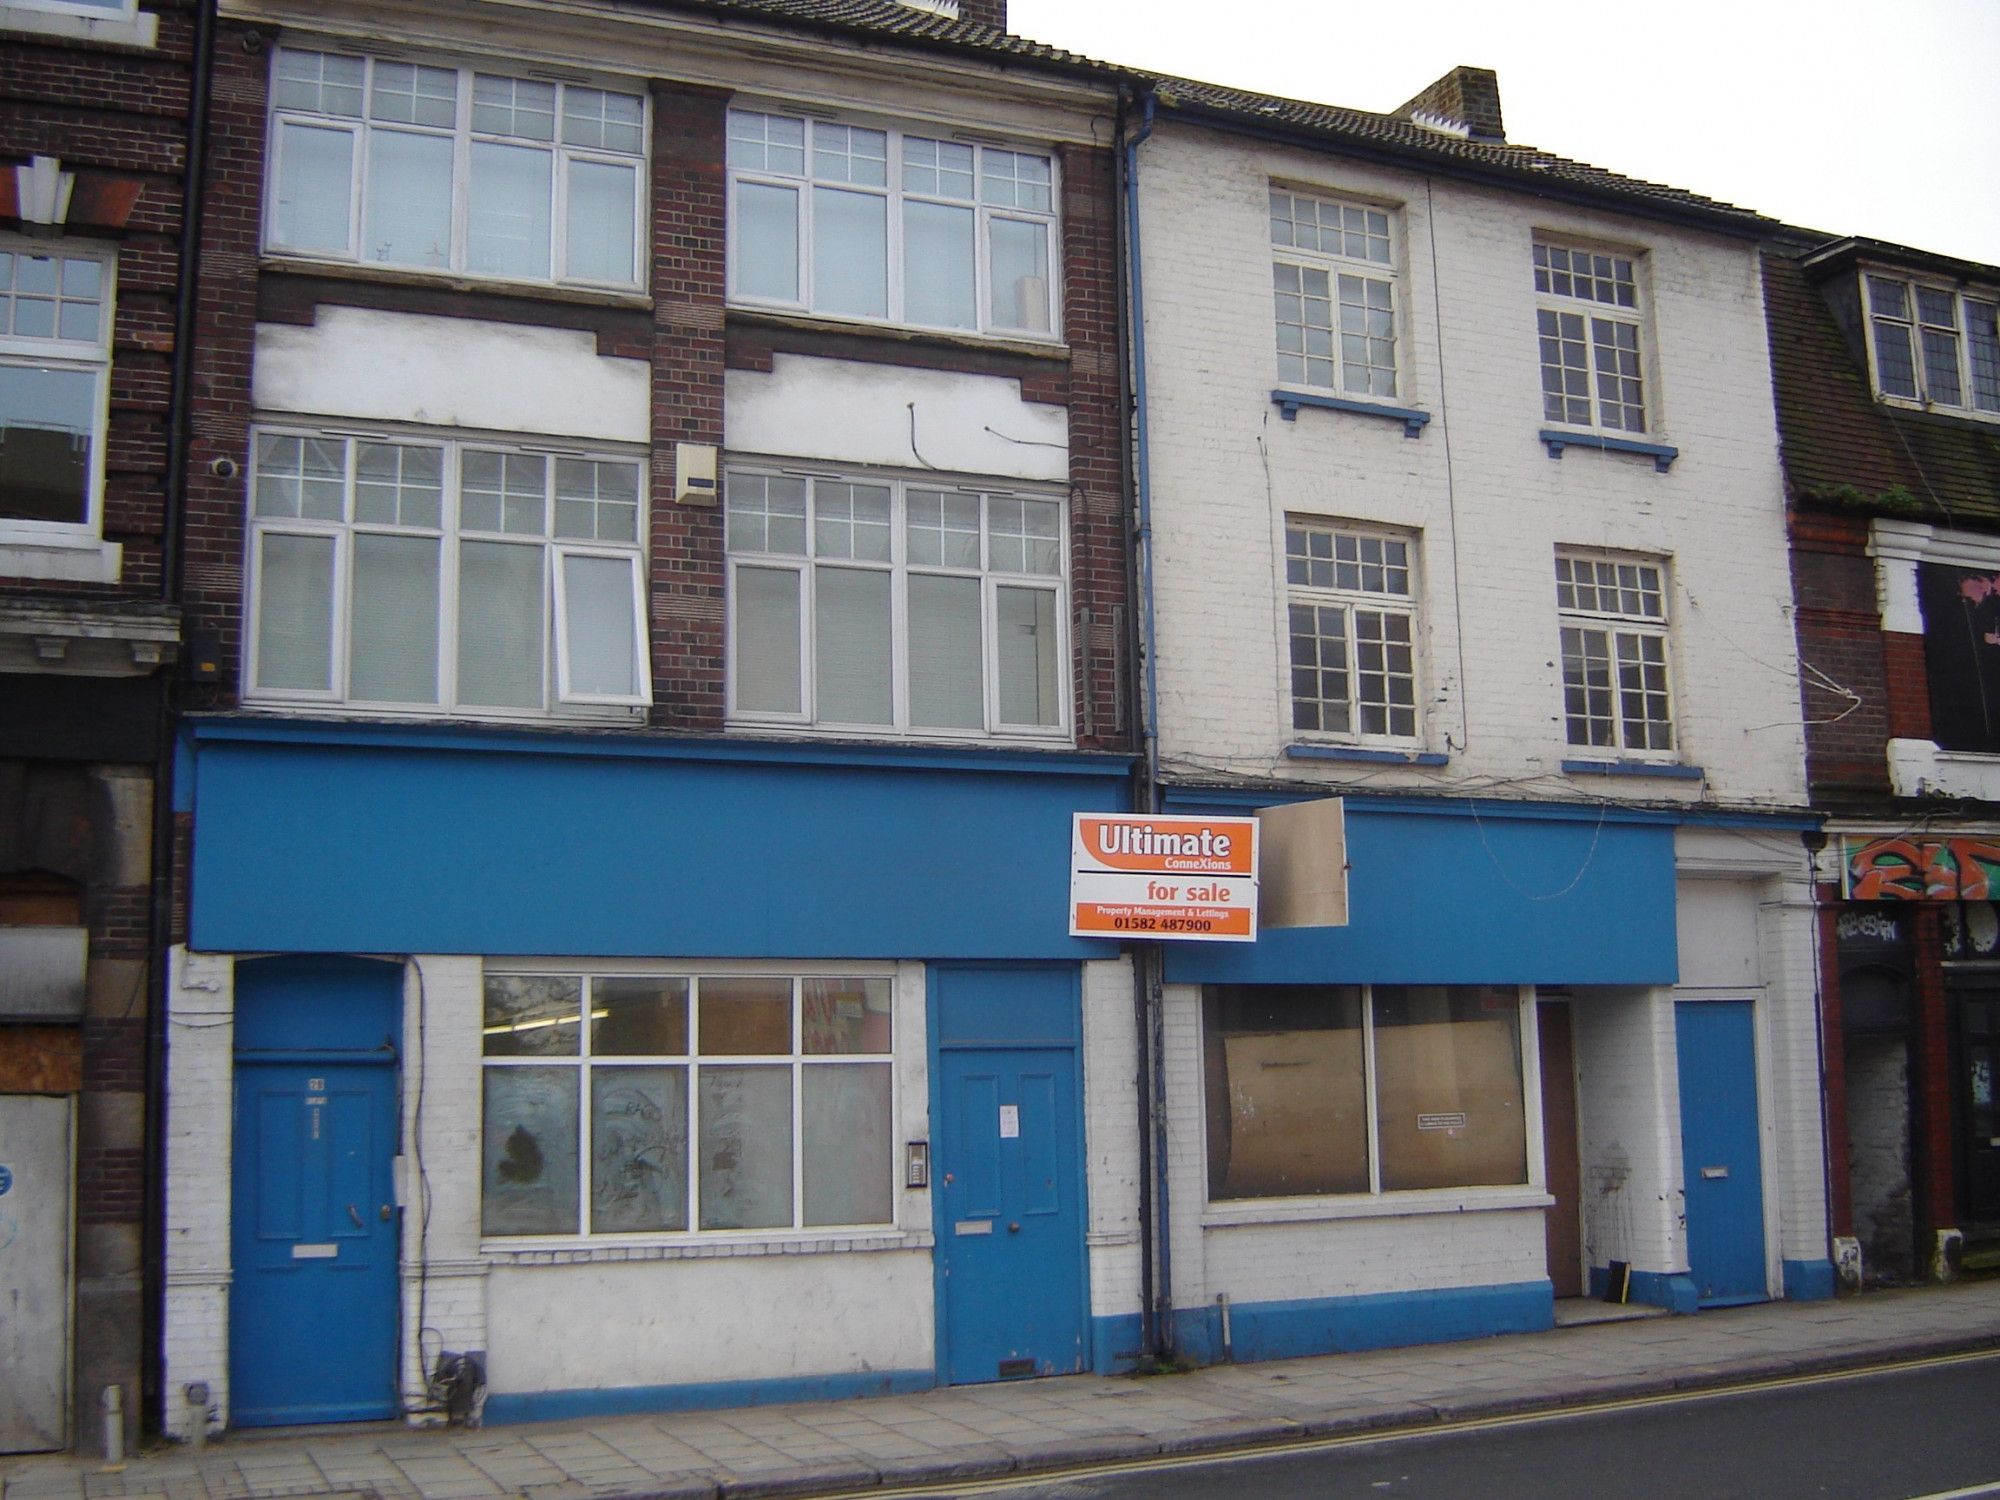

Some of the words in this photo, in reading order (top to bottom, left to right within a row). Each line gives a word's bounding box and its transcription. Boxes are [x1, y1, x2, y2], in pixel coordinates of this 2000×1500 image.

[1099, 824, 1232, 858] Ultimate
[1164, 857, 1232, 870] ConneXions
[1147, 880, 1179, 901] for
[1186, 882, 1231, 902] sale
[1096, 905, 1133, 917] Property
[1133, 906, 1186, 918] Management
[1187, 908, 1195, 917] &
[1196, 908, 1229, 919] Lettings
[1114, 917, 1156, 930] 01582
[1160, 918, 1212, 932] 487900
